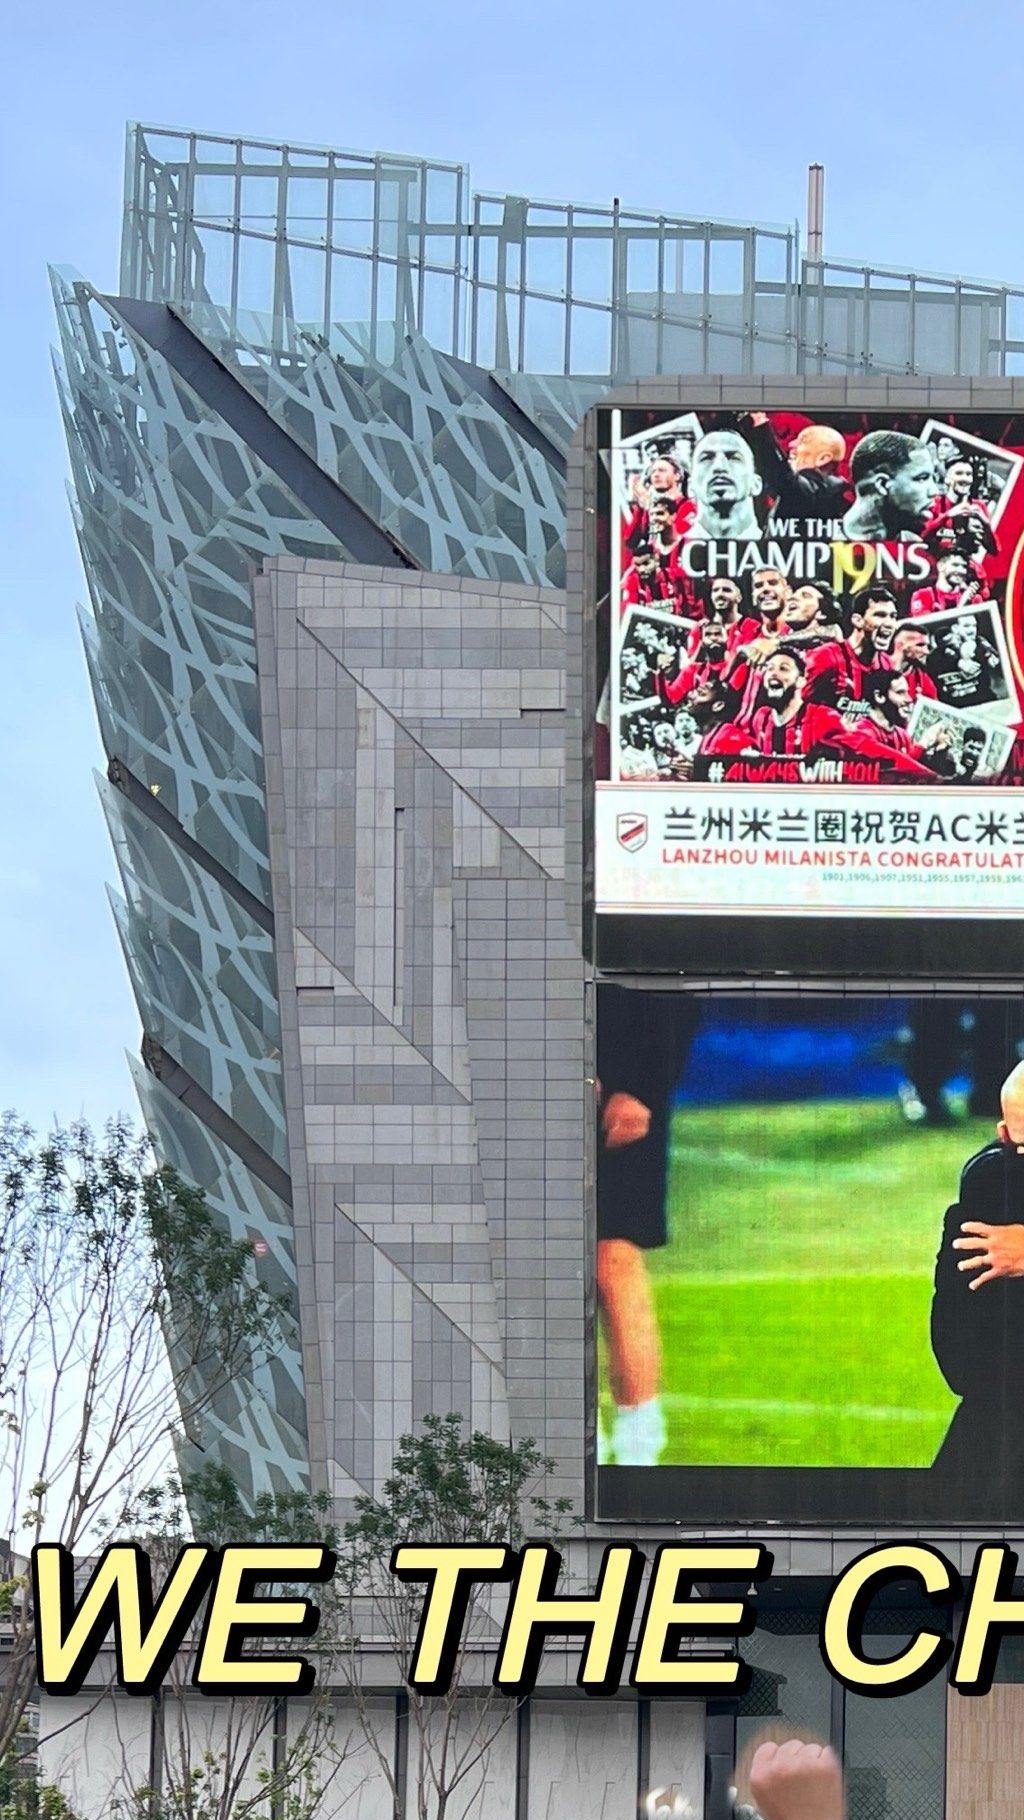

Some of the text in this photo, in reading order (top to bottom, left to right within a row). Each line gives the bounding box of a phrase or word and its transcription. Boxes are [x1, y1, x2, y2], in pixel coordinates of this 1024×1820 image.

[769, 518, 844, 539] WE THE
[682, 540, 931, 594] CHAMP19NS
[662, 848, 758, 865] LANZHOU
[764, 850, 872, 867] MILANISTA
